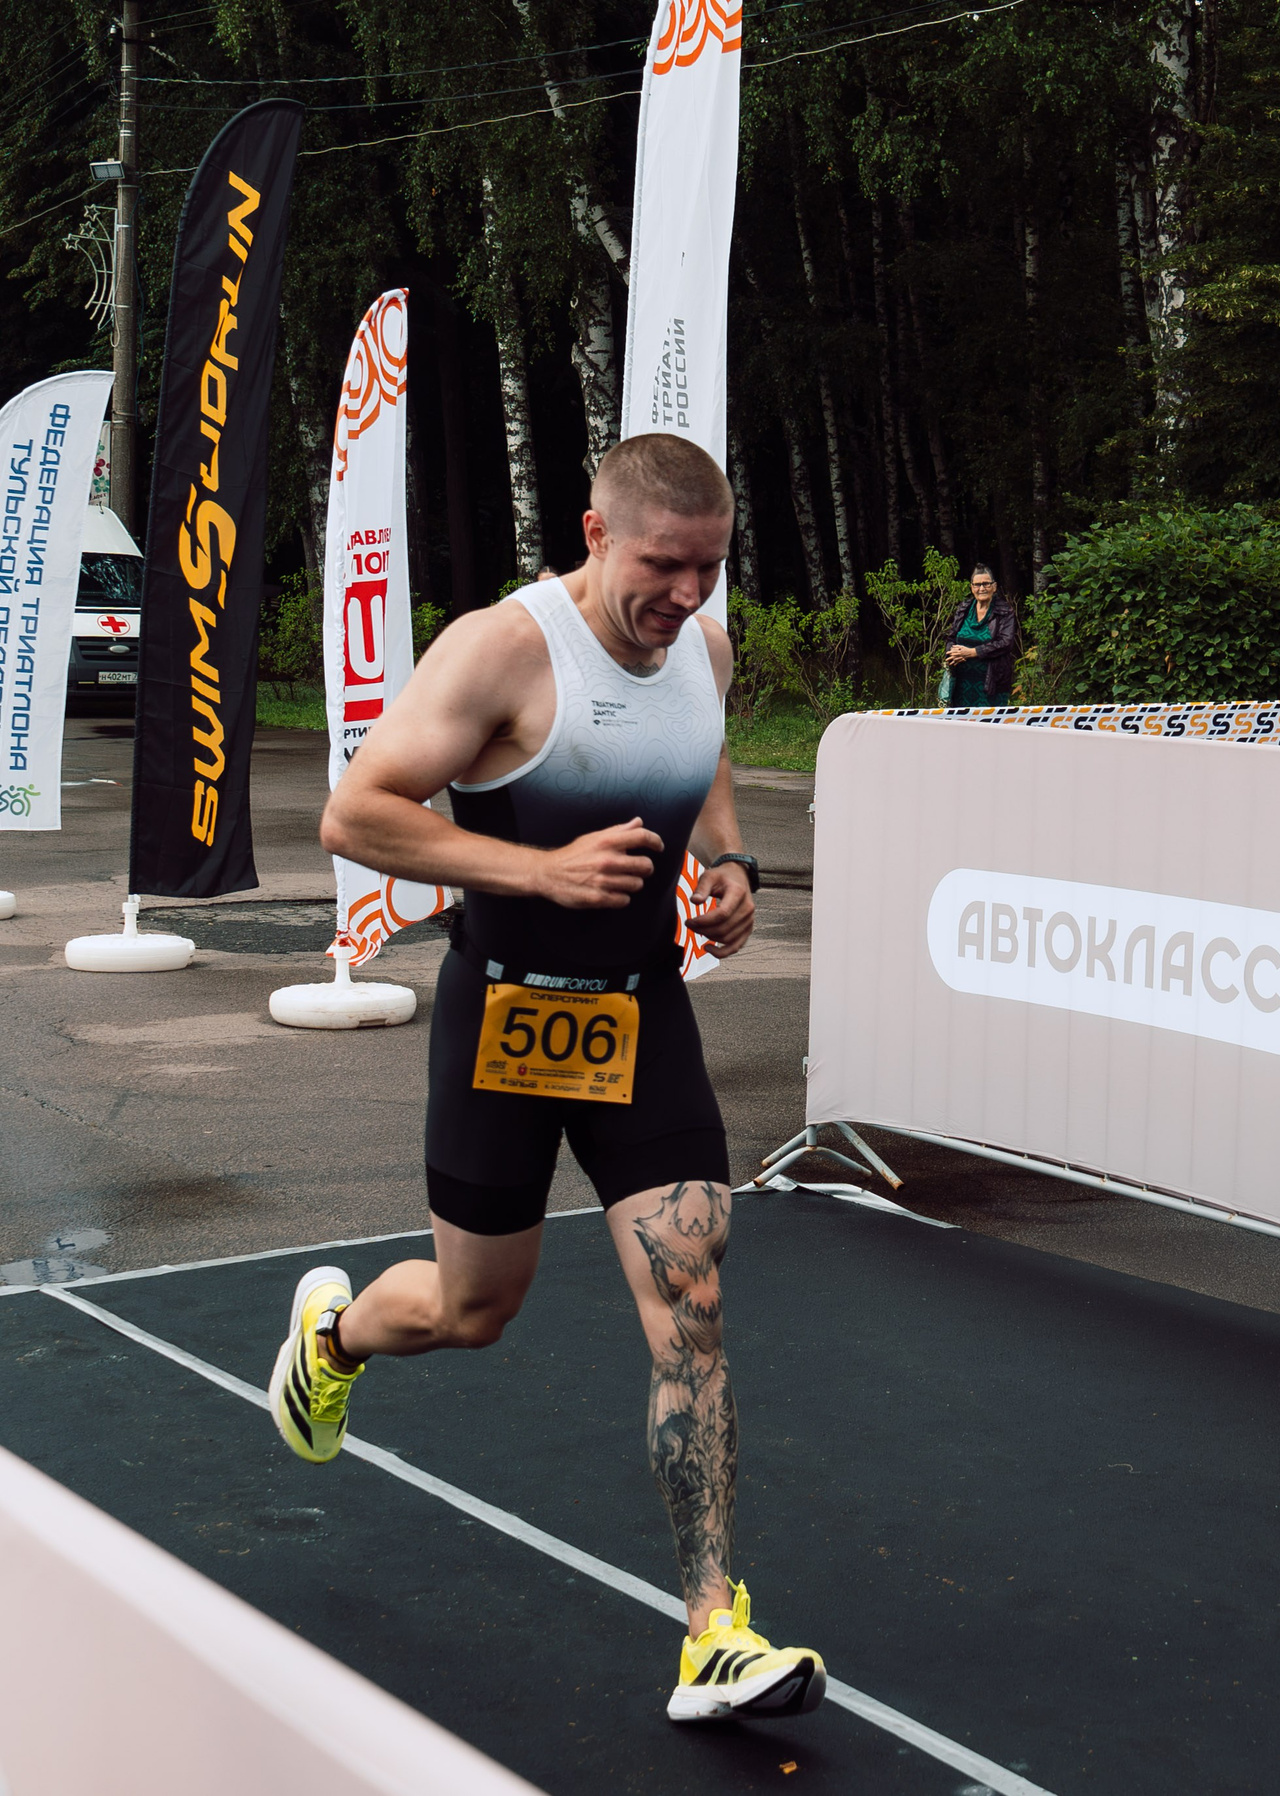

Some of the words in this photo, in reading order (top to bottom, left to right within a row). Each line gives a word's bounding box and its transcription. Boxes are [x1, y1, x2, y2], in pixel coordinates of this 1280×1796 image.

[673, 318, 690, 428] РОССИИ
[0, 439, 34, 594] ТУЛЬСКОЙ
[25, 404, 71, 585] ФЕДЕРАЦИЯ
[10, 598, 40, 771] ТРИАТЛОНА
[500, 1007, 618, 1065] 506
[530, 992, 600, 1005] СУПЕРСПРИНТ
